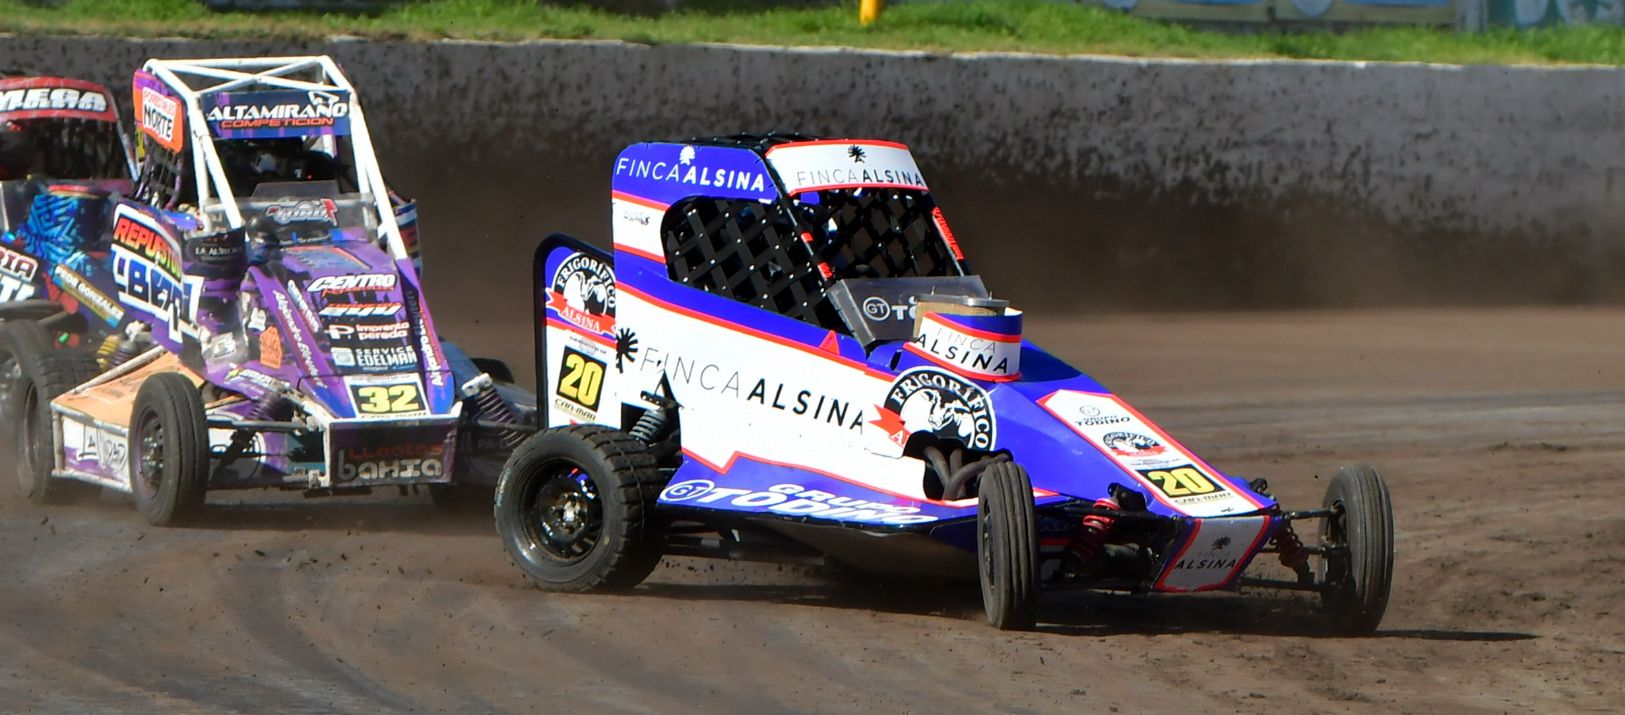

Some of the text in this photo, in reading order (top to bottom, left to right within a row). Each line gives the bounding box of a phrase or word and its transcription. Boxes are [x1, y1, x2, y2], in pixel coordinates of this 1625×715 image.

[144, 104, 173, 138] NORTE
[207, 103, 348, 120] ALTAMIRANO
[221, 117, 334, 129] COMPETICION
[307, 274, 396, 292] CENTRO
[562, 306, 601, 331] ALSINA
[356, 346, 414, 356] SERVICE
[357, 352, 418, 367] EDELMAN
[915, 334, 1008, 374] ALSINA
[560, 353, 602, 406] 20
[358, 385, 419, 414] 32
[1148, 468, 1215, 496] 20
[697, 488, 939, 524] TODINO
[768, 484, 921, 513] GRUPO
[1175, 559, 1237, 569] ALSINA
